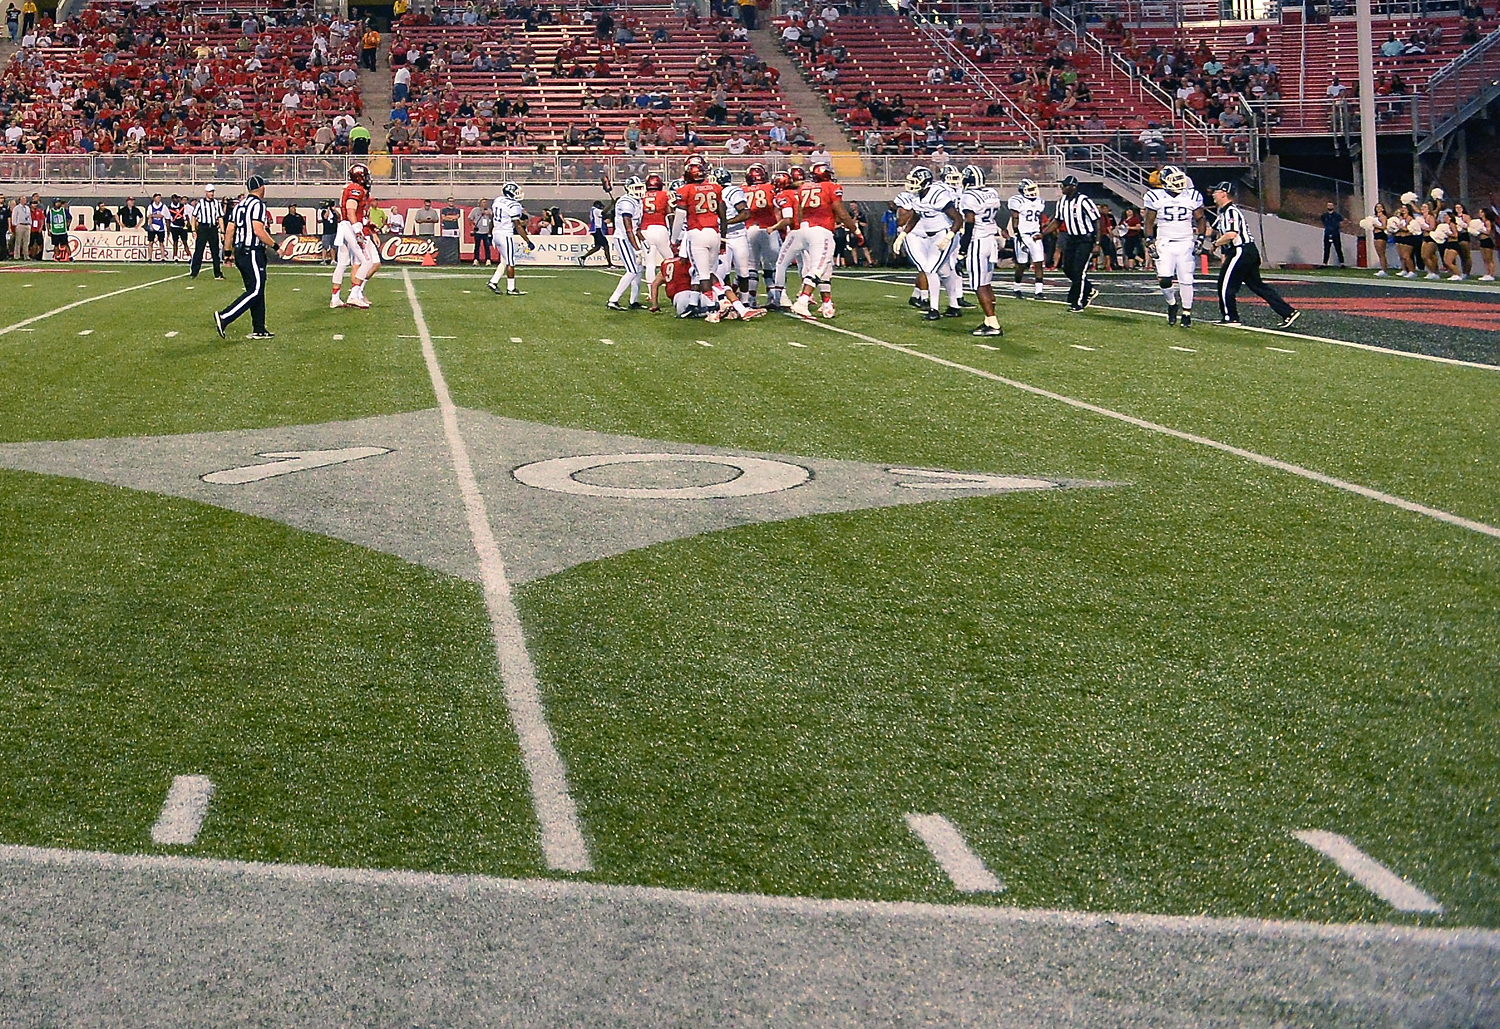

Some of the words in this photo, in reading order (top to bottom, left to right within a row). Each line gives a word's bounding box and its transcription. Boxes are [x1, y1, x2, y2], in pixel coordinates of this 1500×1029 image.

[644, 197, 656, 214] 5
[694, 192, 718, 213] 26
[744, 190, 767, 209] 78
[801, 188, 822, 208] 75
[494, 206, 503, 222] 11
[1163, 206, 1188, 222] 52
[81, 248, 122, 259] HEART
[124, 248, 169, 260] CENER
[381, 236, 438, 261] Cane's
[665, 262, 675, 282] 9
[198, 445, 815, 500] 10
